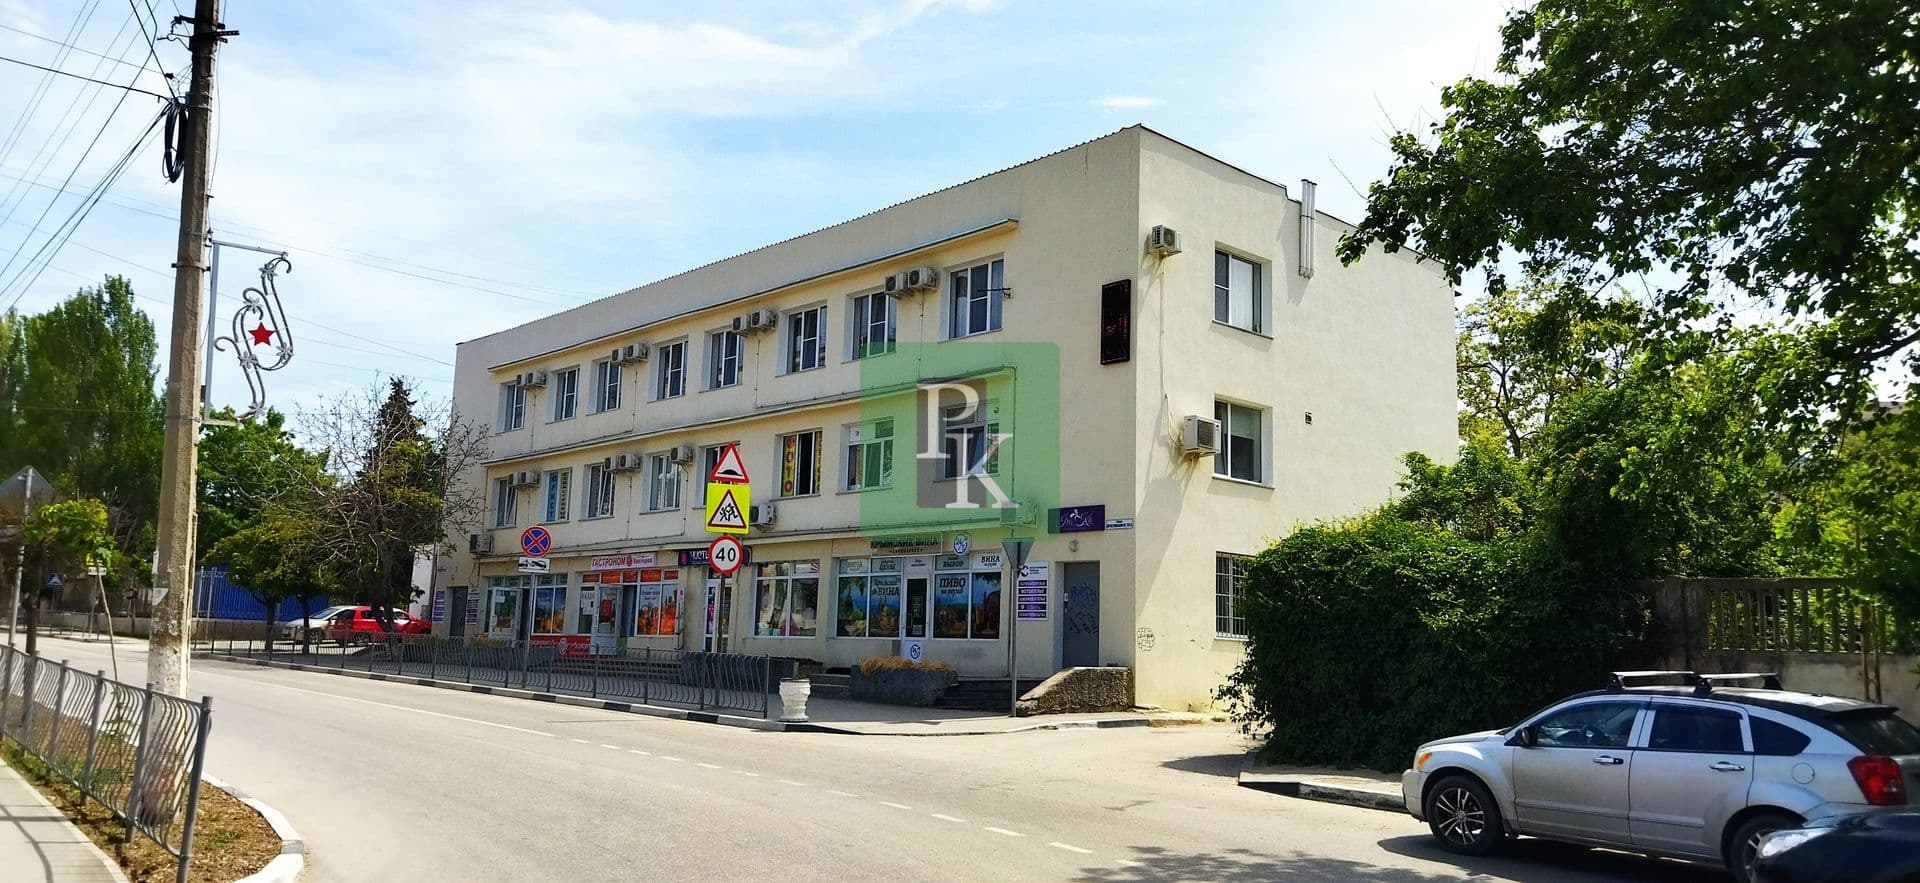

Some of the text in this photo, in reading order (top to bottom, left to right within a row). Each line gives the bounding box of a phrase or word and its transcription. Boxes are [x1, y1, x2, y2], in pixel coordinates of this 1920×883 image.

[716, 547, 736, 562] 40
[981, 555, 1000, 563] ВИНА
[592, 555, 626, 567] ГАСТРОНОМ
[939, 577, 966, 588] ПИВО
[878, 587, 900, 596] ВИНА
